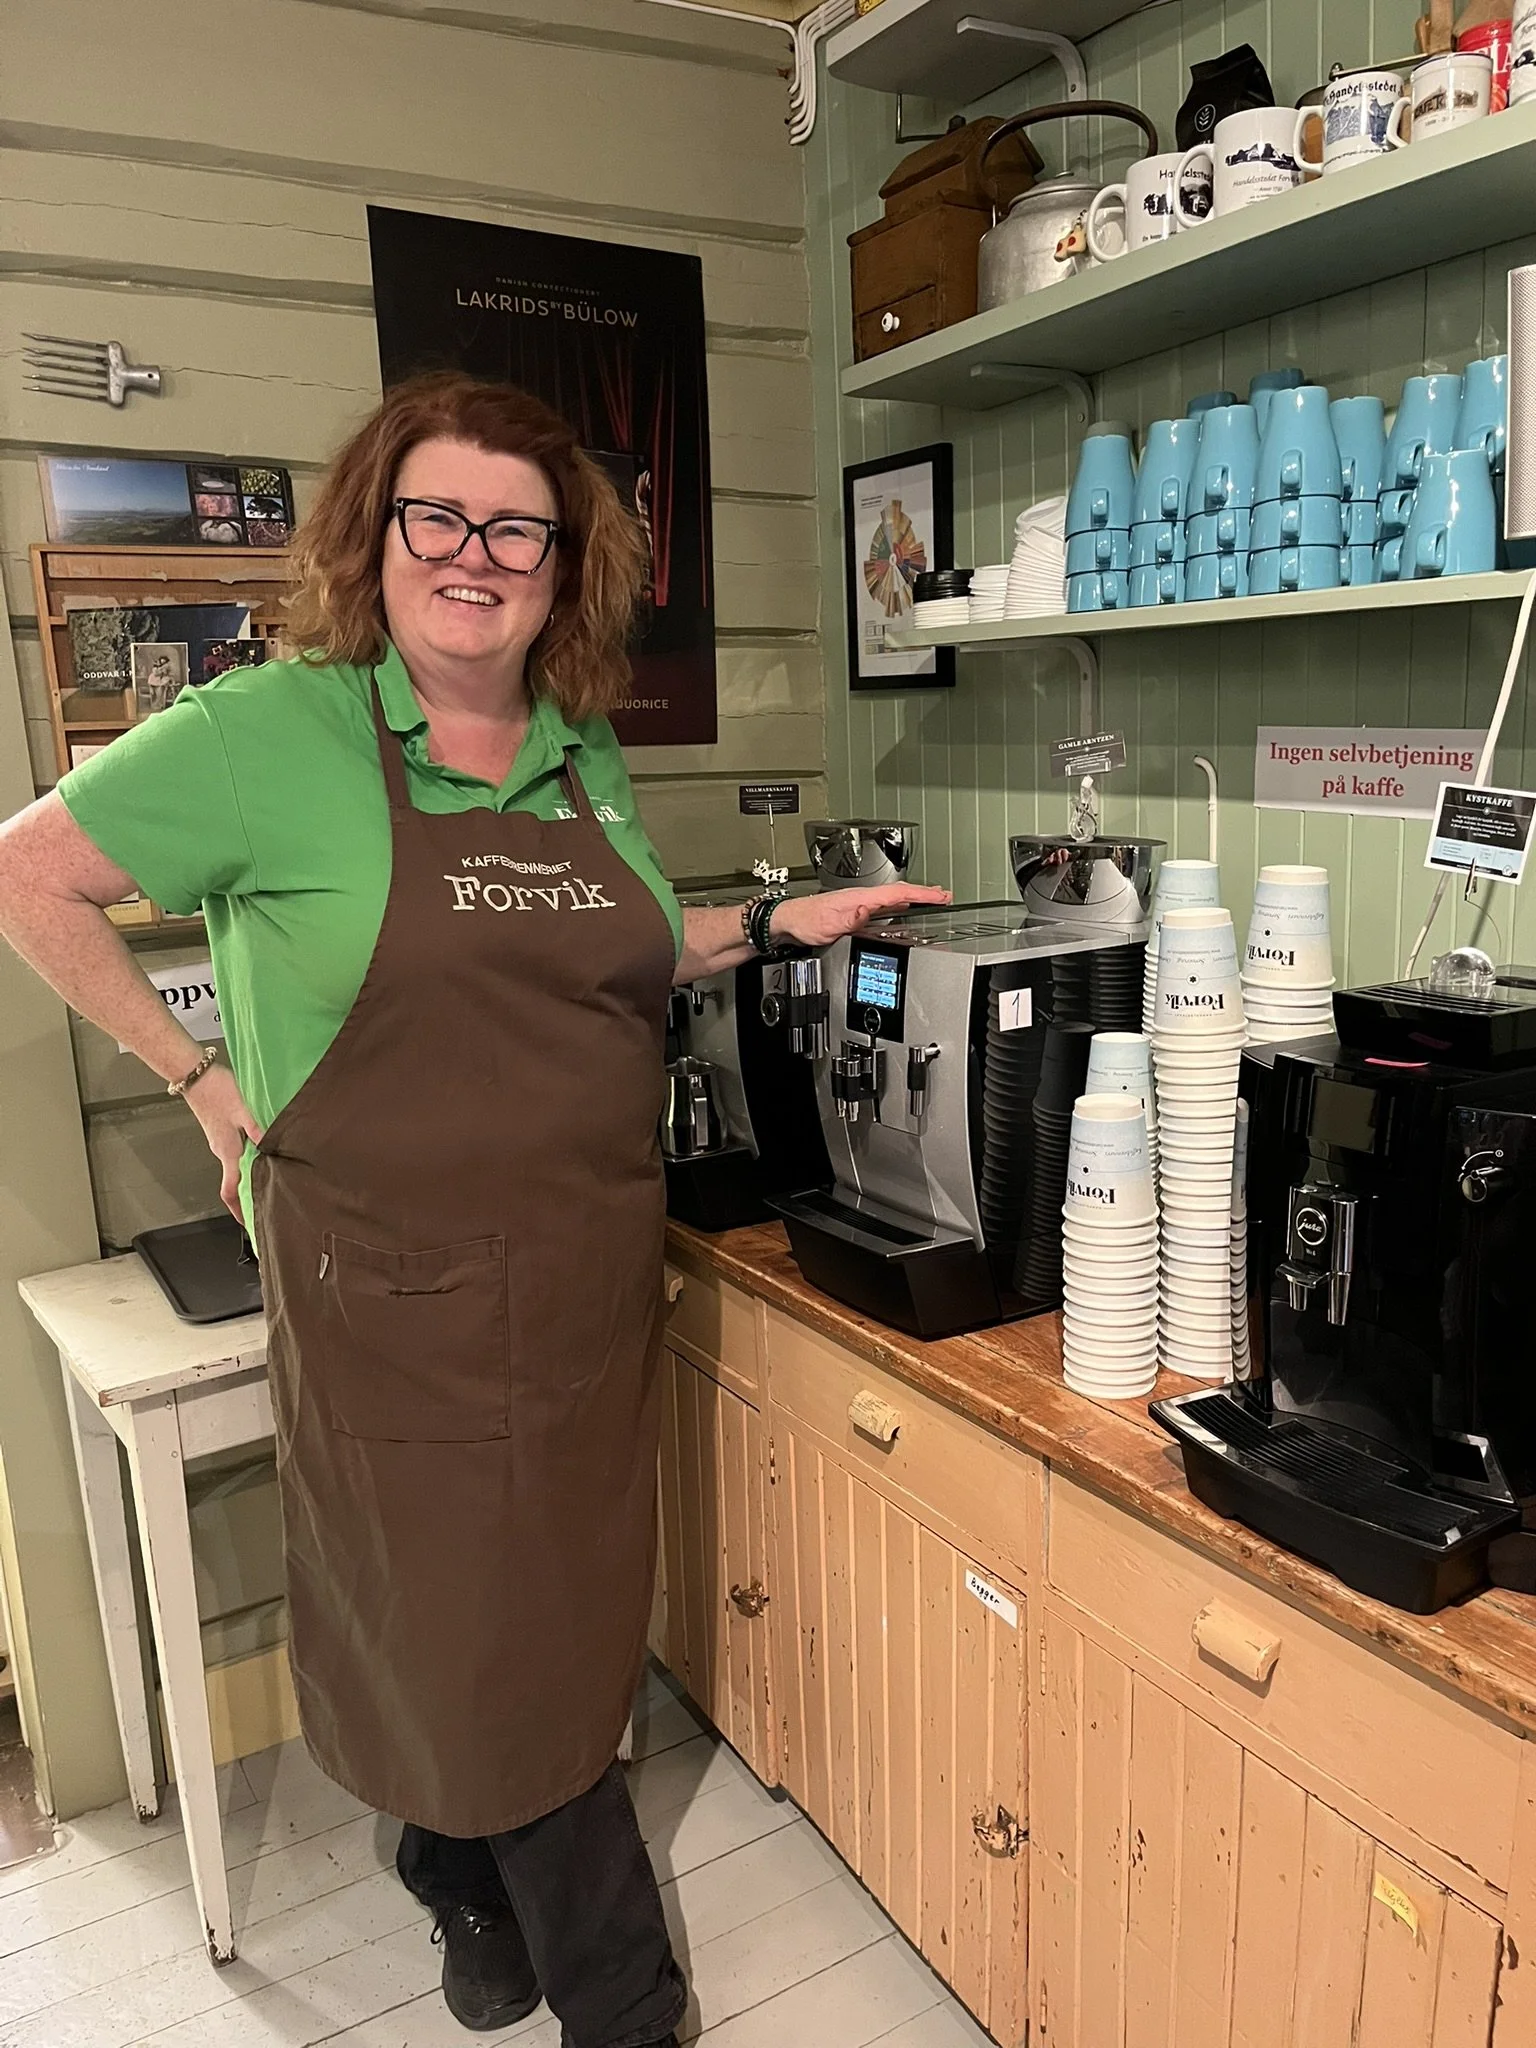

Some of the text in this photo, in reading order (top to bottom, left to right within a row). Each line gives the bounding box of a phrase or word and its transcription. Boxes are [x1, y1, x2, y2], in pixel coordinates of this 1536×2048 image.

[456, 288, 638, 328] LAKRIDS BY BÜLOW
[84, 670, 120, 679] ODDVAR
[615, 699, 669, 709] QUORICE
[1058, 734, 1115, 750] GAMLE ARNTZEN
[1270, 742, 1474, 772] Ingen selvbetjening
[1322, 775, 1404, 798] på kaffe
[1465, 793, 1513, 808] KYSTKAFFE
[554, 806, 626, 822] Fvik
[461, 855, 571, 875] KAFFEBRENNERIET
[443, 874, 617, 912] Forvik
[772, 968, 783, 991] 2
[1012, 992, 1020, 1026] 1
[1165, 993, 1224, 1010] Forvik
[1298, 1218, 1322, 1233] jura
